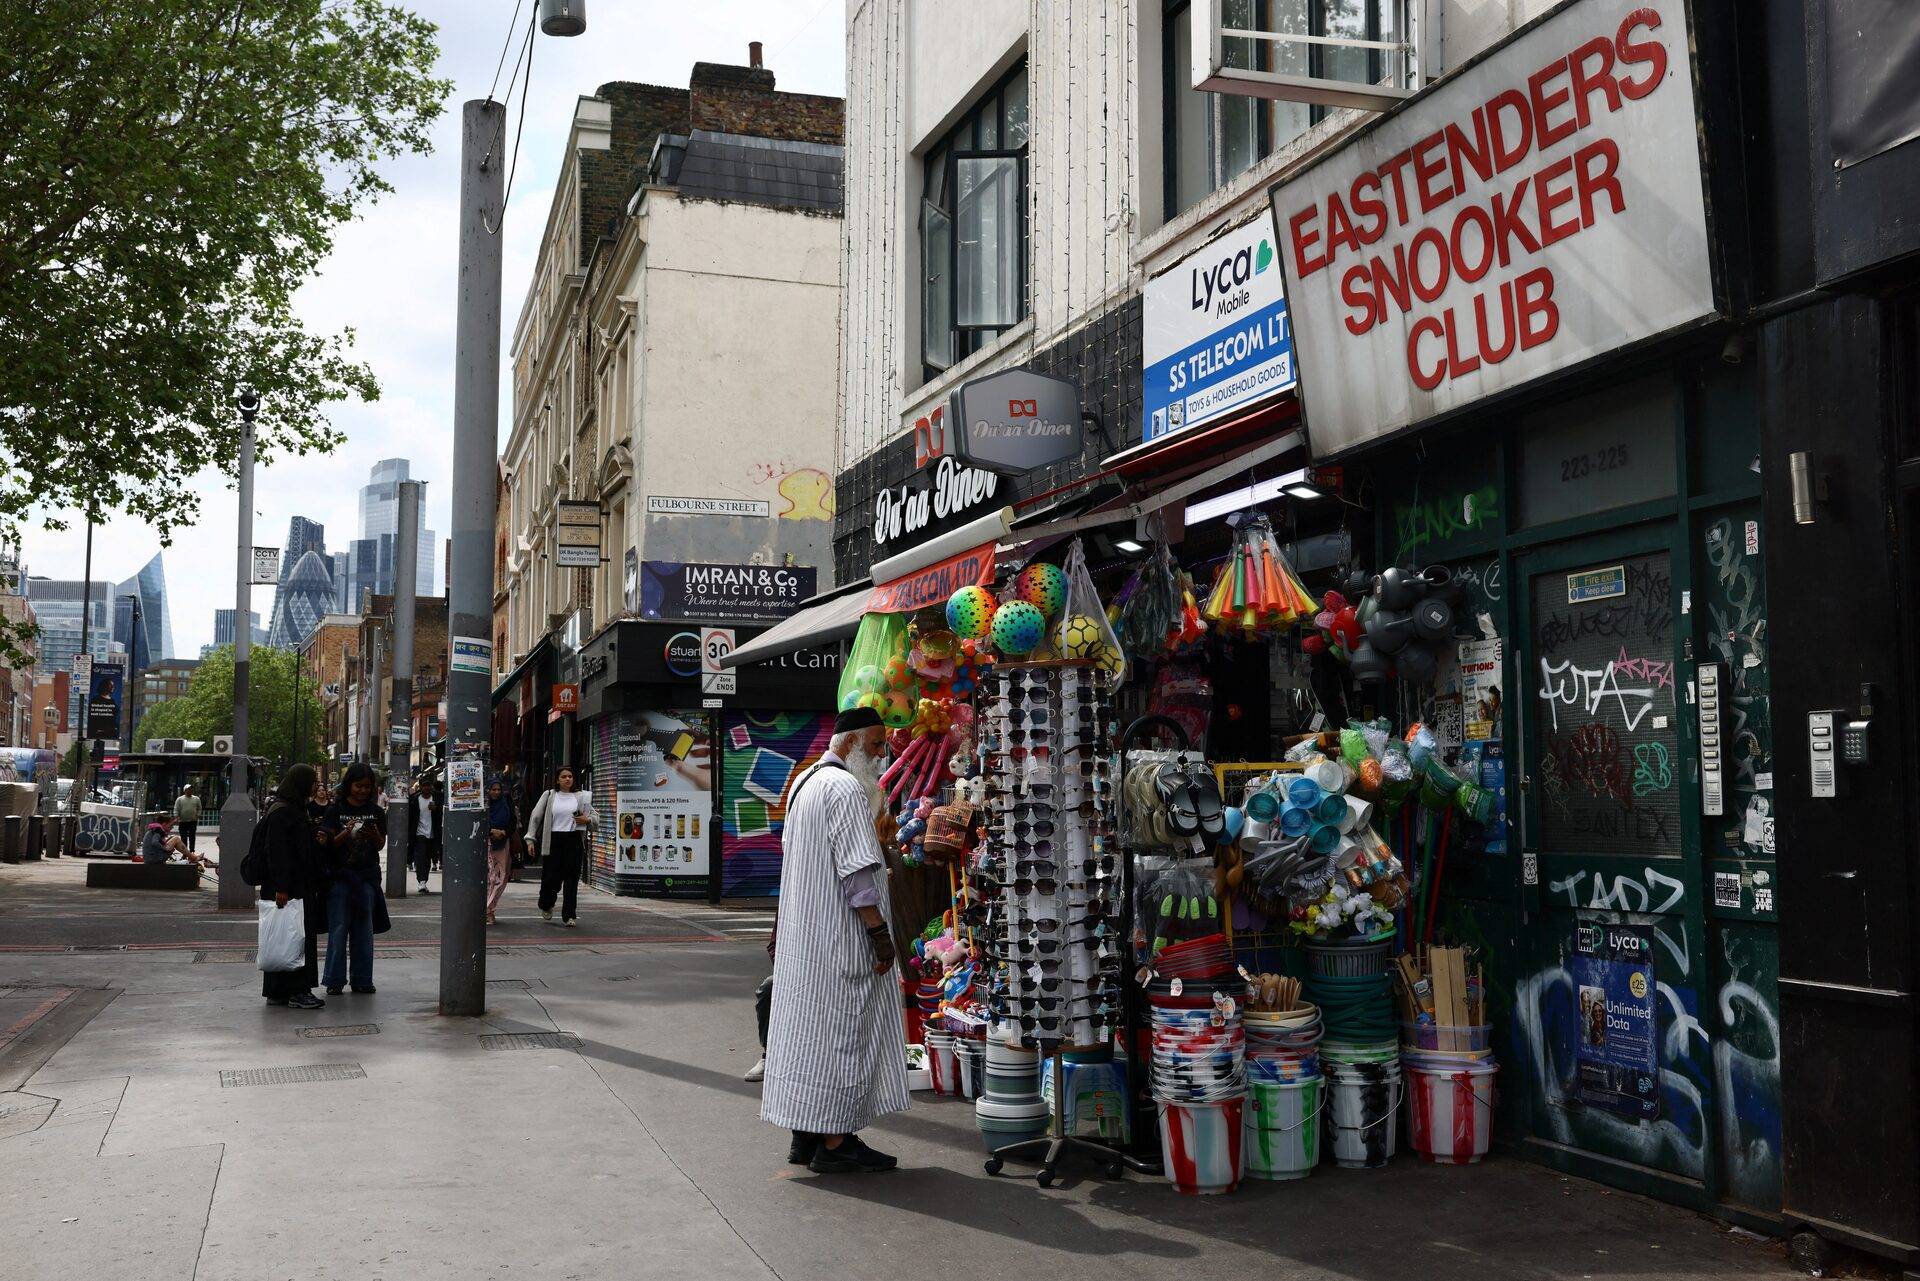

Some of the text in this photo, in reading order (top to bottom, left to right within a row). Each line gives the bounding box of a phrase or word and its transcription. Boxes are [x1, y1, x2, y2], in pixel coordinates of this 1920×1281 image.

[1290, 9, 1667, 279] EASTENDERS
[1340, 138, 1626, 336] SNOOKER
[1192, 246, 1252, 312] Lyca
[1216, 290, 1250, 319] Mobile
[1406, 266, 1560, 391] CLUB
[1169, 310, 1291, 393] SS TELECOM LT
[1188, 362, 1286, 414] TOYS & HOUSEHOLD GOODS
[973, 419, 1073, 439] Du'aa Diner
[1561, 444, 1627, 482] 223-225
[651, 499, 715, 511] FULBOURNE
[718, 502, 757, 512] STREET
[875, 456, 997, 544] Du'aa Diner
[685, 567, 797, 587] IMRAN & Co
[956, 556, 980, 589] LTD
[1584, 571, 1615, 585] Fire exit
[686, 583, 798, 597] SOLICITORS
[1584, 584, 1616, 597] Keep clear
[684, 594, 796, 611] Where trust meets expertise
[708, 643, 729, 658] 30
[637, 754, 658, 762] Prints
[1609, 931, 1640, 951] Lyca
[1631, 979, 1645, 990] £25
[1606, 1000, 1651, 1021] Unlimited
[1606, 1015, 1631, 1031] Data
